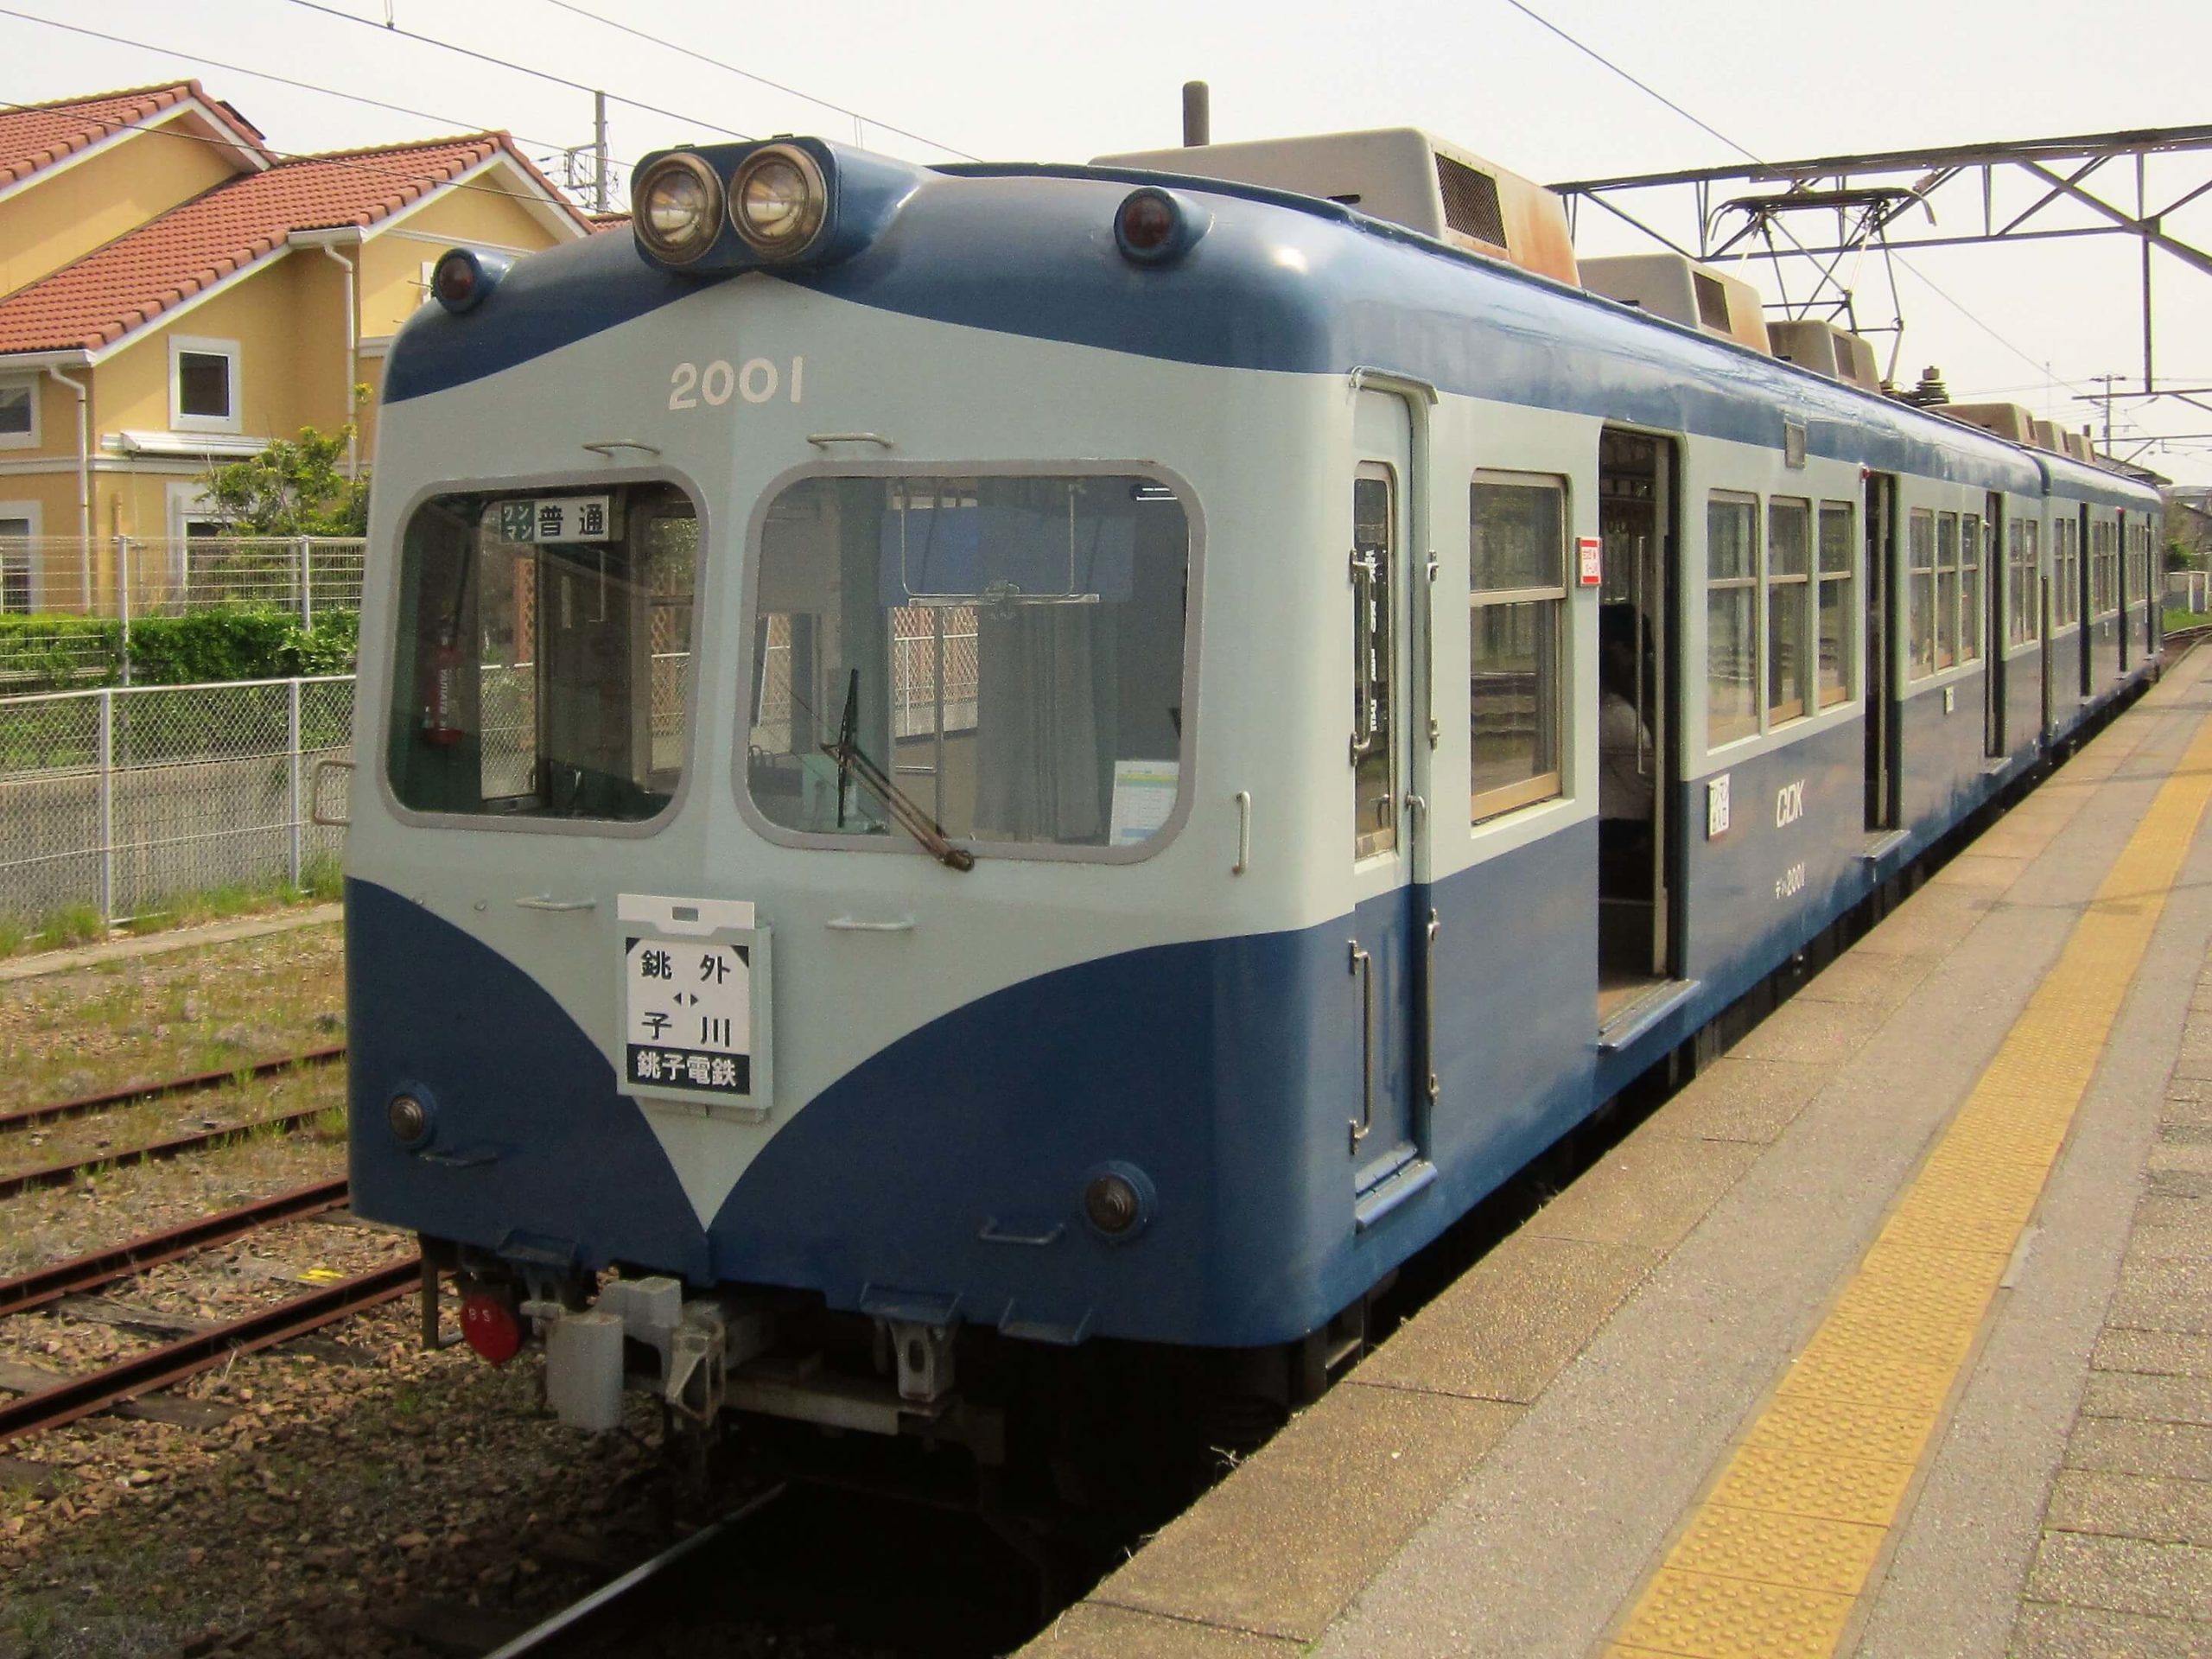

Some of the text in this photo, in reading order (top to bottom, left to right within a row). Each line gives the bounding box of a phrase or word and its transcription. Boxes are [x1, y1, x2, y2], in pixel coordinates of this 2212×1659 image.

[669, 355, 804, 410] 2001
[538, 504, 604, 537] 普通
[1777, 779, 1804, 828] CDK
[637, 1050, 737, 1087] 銚子電鉄
